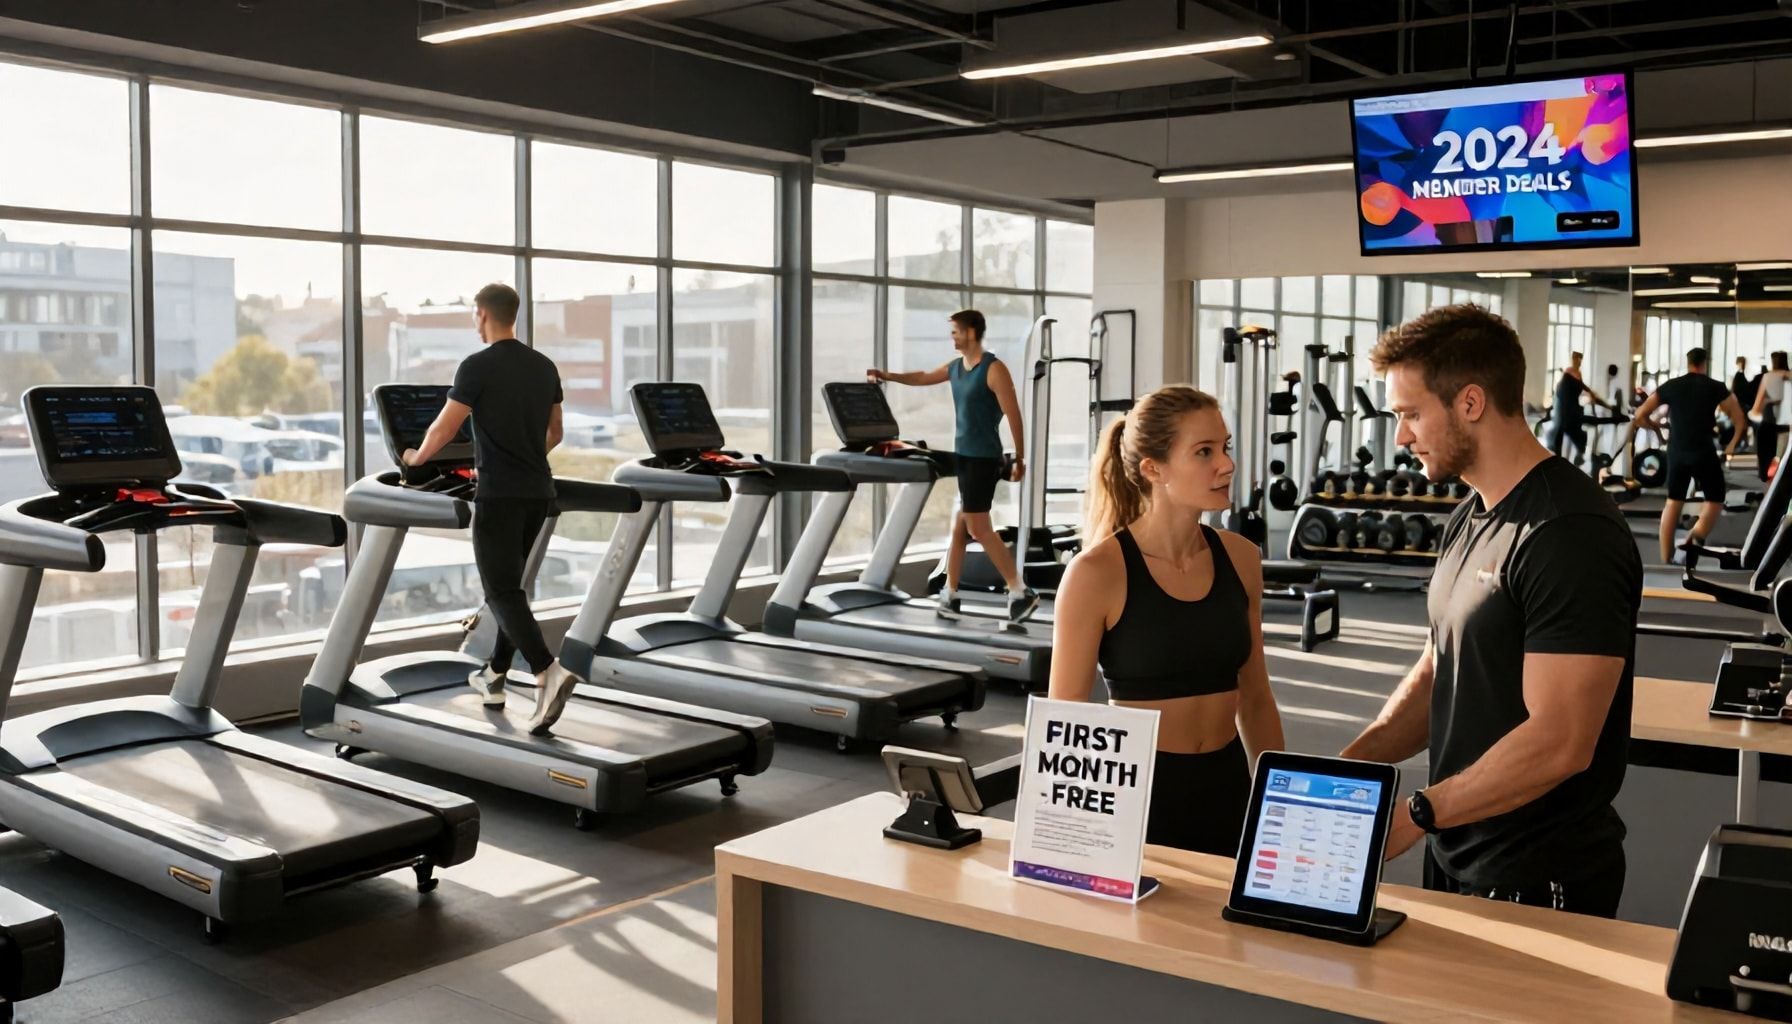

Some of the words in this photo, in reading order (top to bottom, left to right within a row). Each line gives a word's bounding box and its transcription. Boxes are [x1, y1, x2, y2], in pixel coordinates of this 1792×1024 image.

[1432, 122, 1566, 174] 2024
[1506, 170, 1572, 193] DEALS
[1046, 720, 1128, 753] FIRST
[1038, 750, 1138, 787] MONTH
